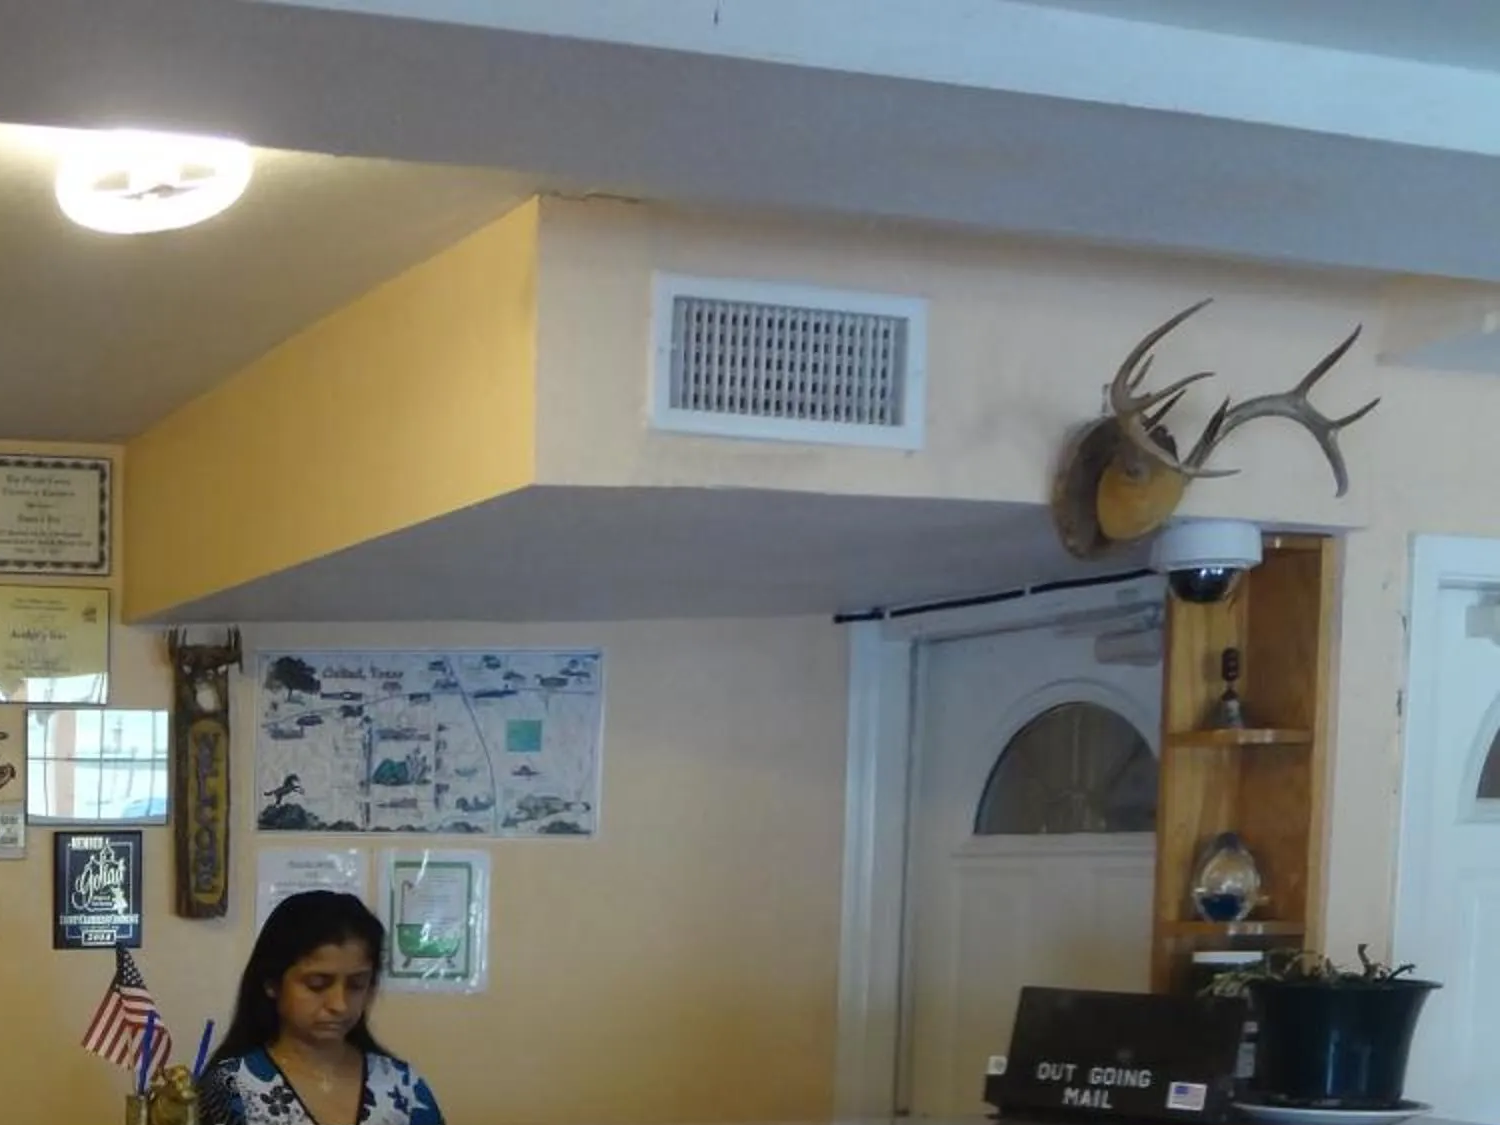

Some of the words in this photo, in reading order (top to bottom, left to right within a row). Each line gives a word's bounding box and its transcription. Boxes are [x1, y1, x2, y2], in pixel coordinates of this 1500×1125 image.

[1036, 1062, 1078, 1081] OUT
[1089, 1067, 1153, 1088] GOING
[1062, 1087, 1113, 1109] MAIL
